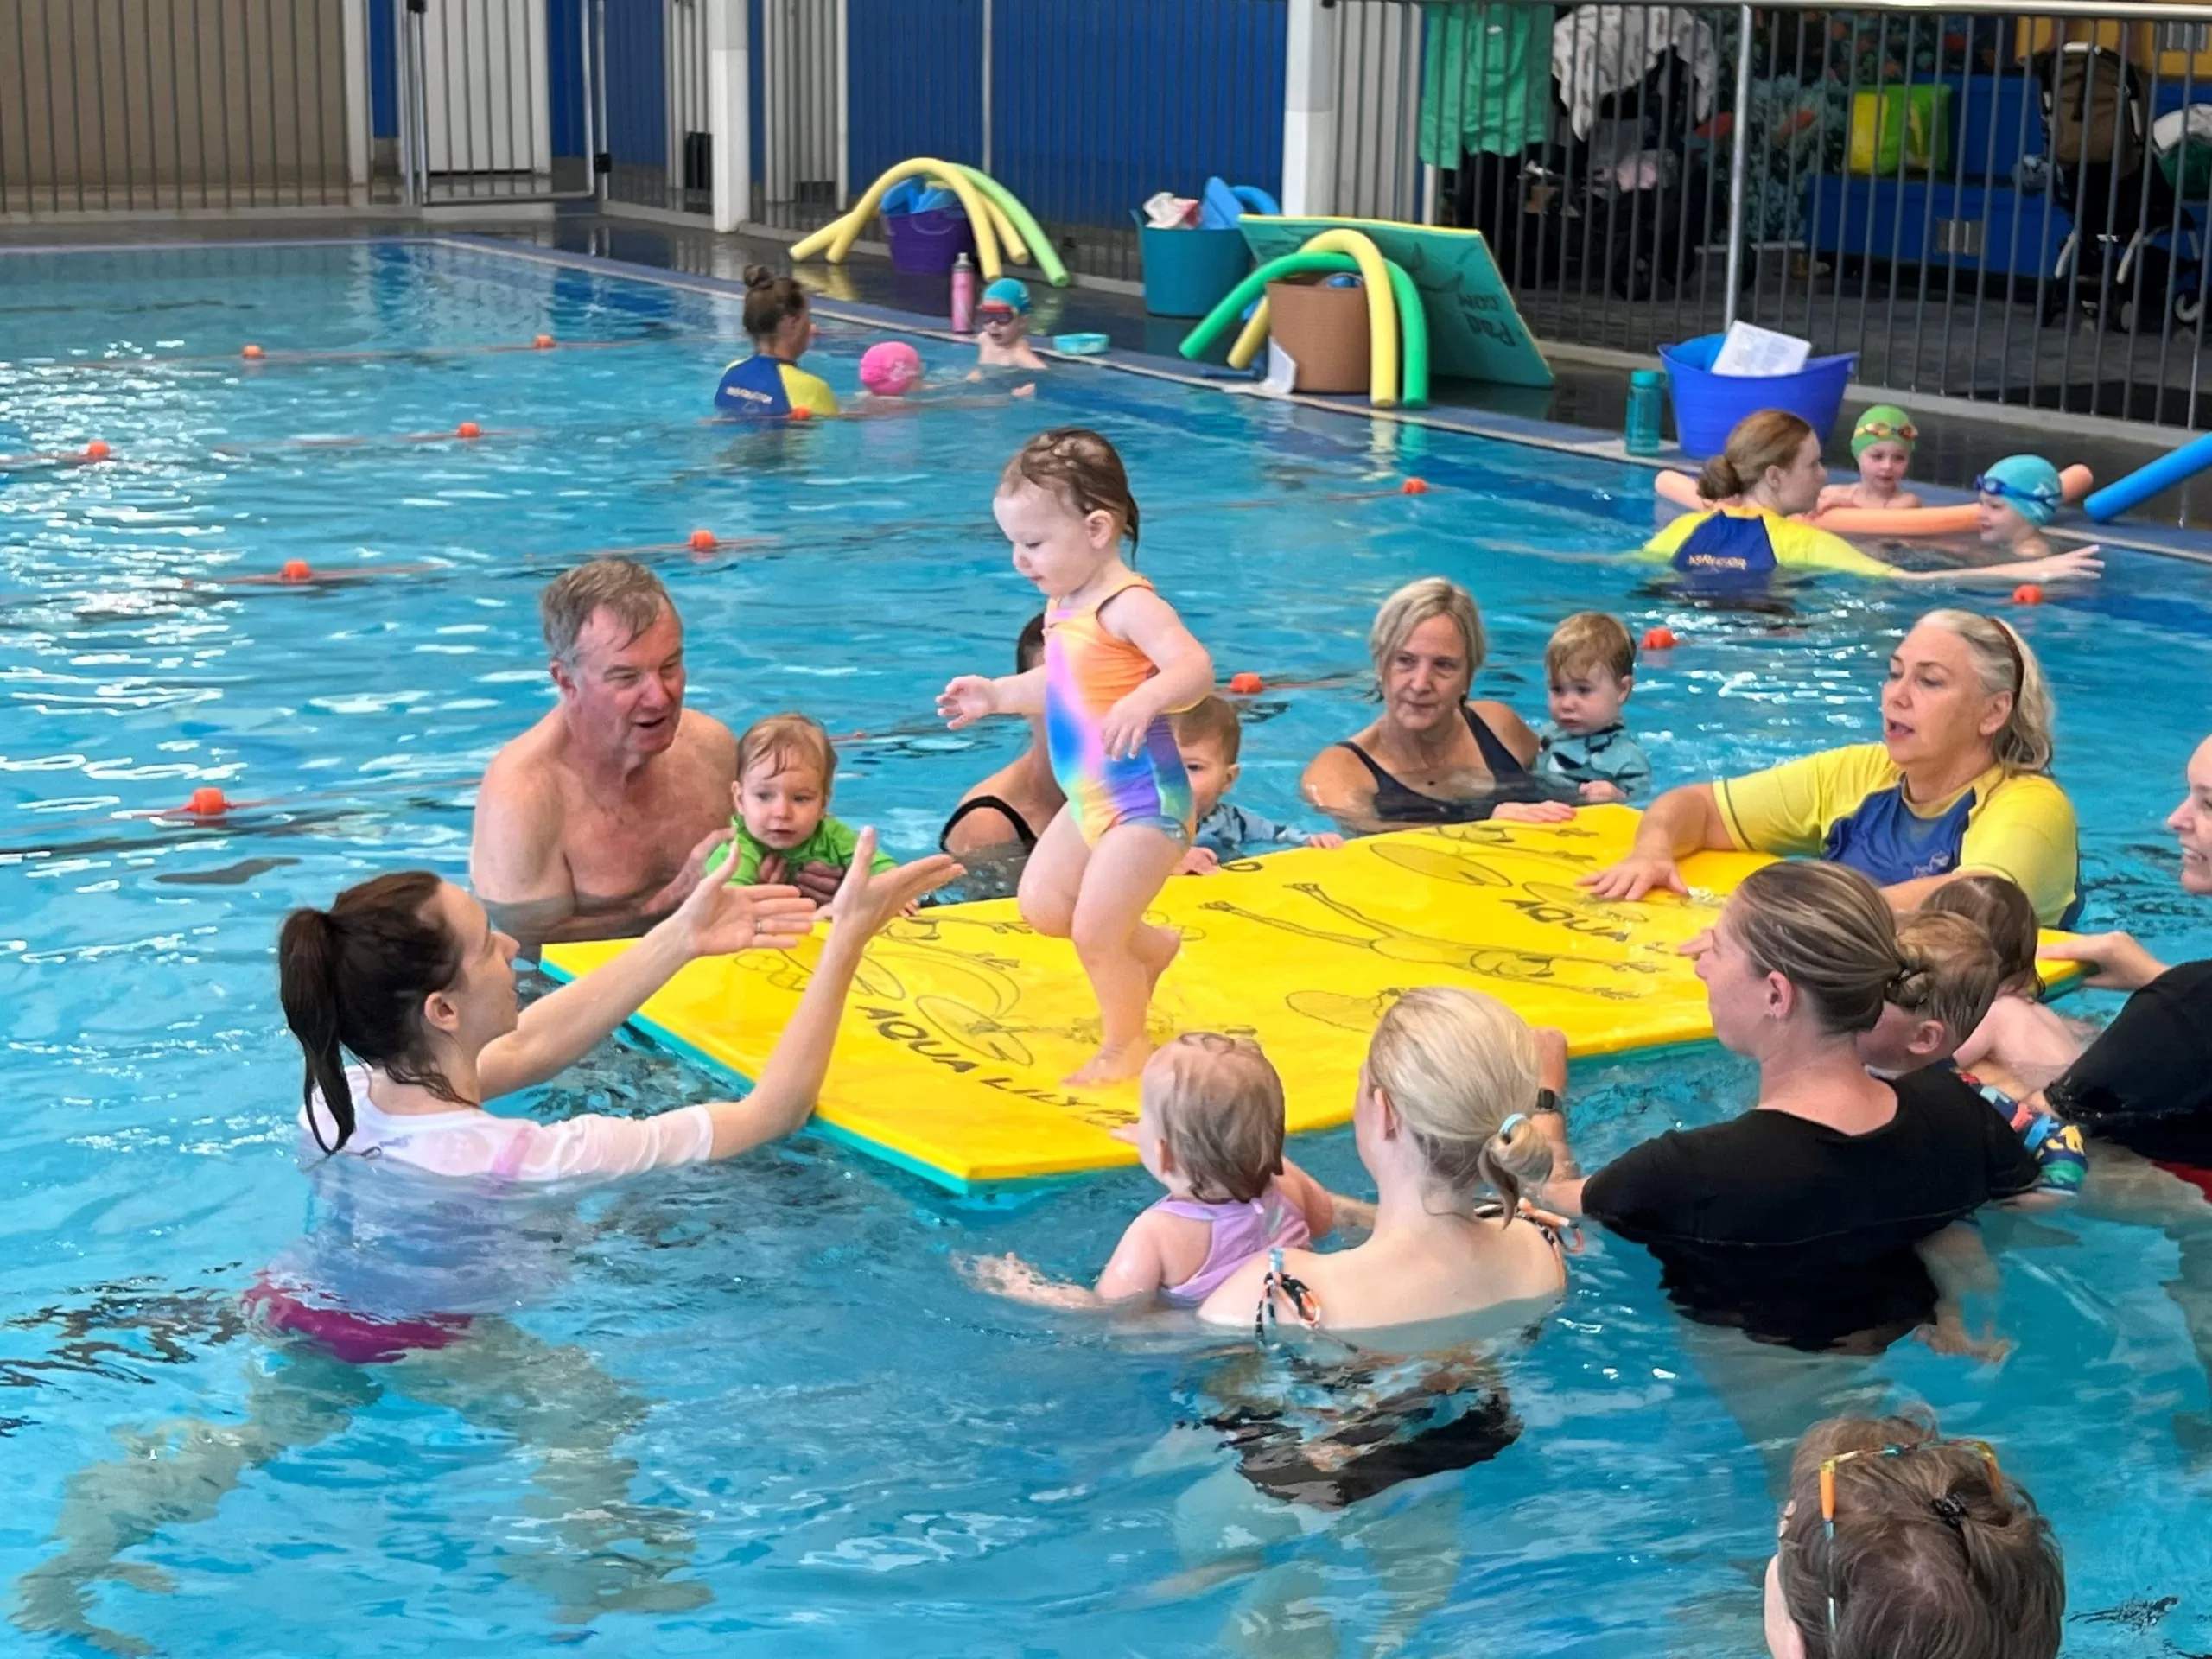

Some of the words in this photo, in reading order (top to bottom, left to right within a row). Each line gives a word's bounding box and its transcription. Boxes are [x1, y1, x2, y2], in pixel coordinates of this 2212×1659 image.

[1498, 899, 1631, 943] AQUA
[855, 1005, 980, 1073] AQUA
[980, 1077, 1101, 1108] LILY
